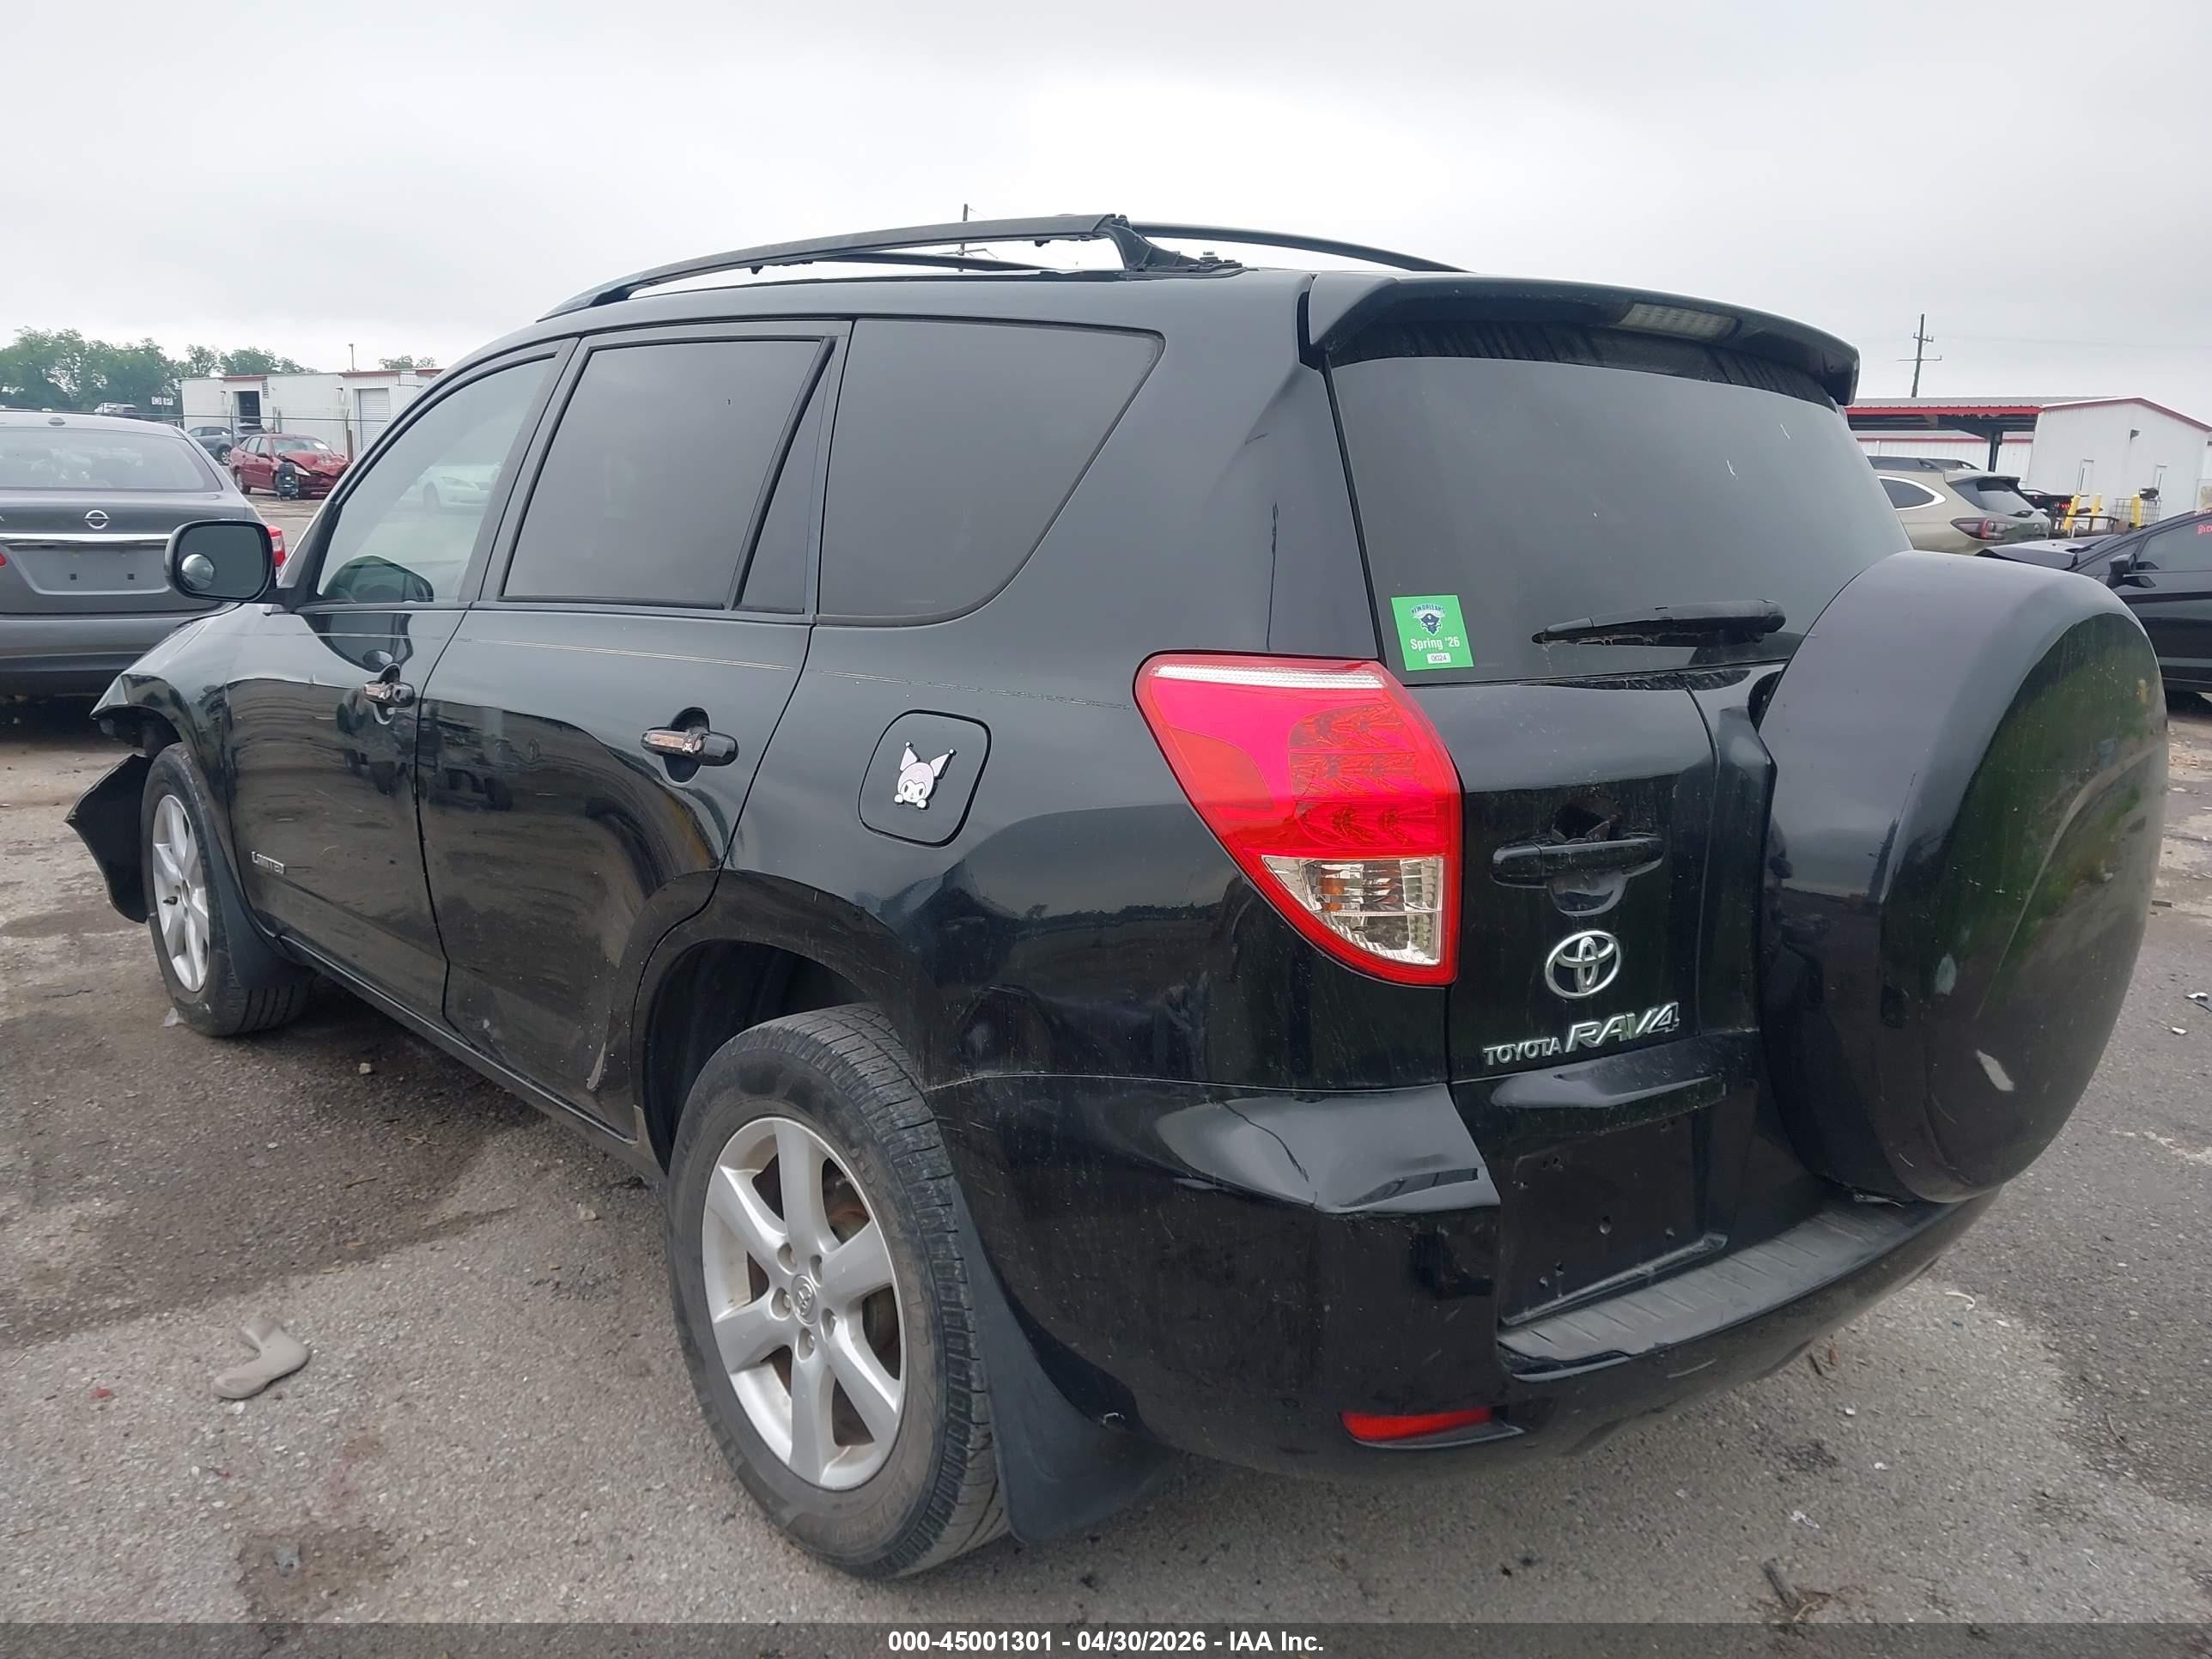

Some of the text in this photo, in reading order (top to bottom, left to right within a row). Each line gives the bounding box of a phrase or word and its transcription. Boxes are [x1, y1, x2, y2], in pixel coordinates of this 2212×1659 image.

[1410, 637, 1443, 653] Spring
[1565, 1000, 1680, 1054] RAV4
[1483, 1036, 1563, 1066] TOYOTA
